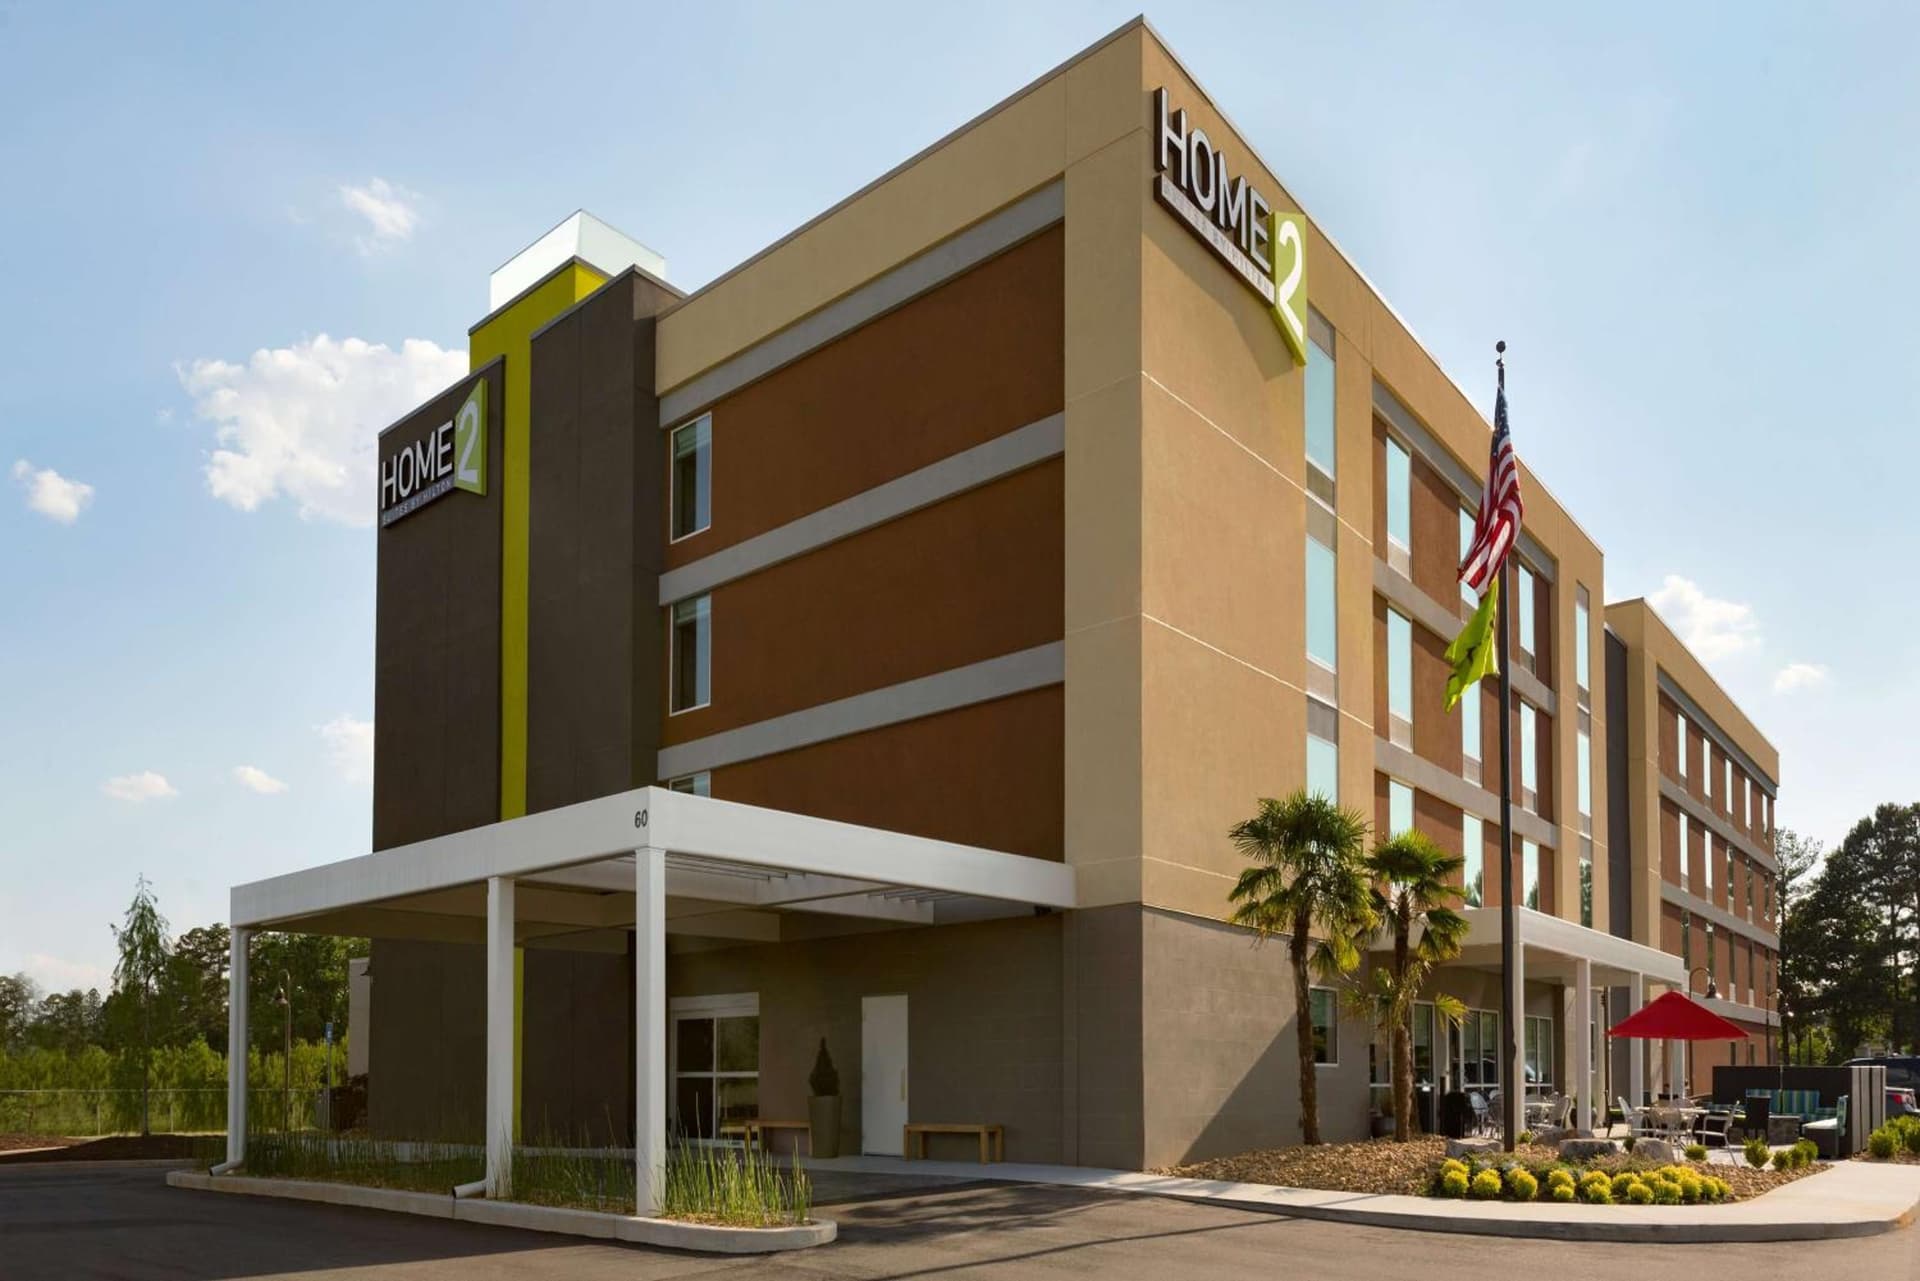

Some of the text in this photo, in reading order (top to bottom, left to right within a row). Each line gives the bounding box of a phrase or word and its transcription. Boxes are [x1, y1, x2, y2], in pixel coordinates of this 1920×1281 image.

[1154, 86, 1271, 274] HOME
[1279, 219, 1304, 345] 2
[382, 401, 479, 509] HOME 2
[634, 809, 648, 828] 60
